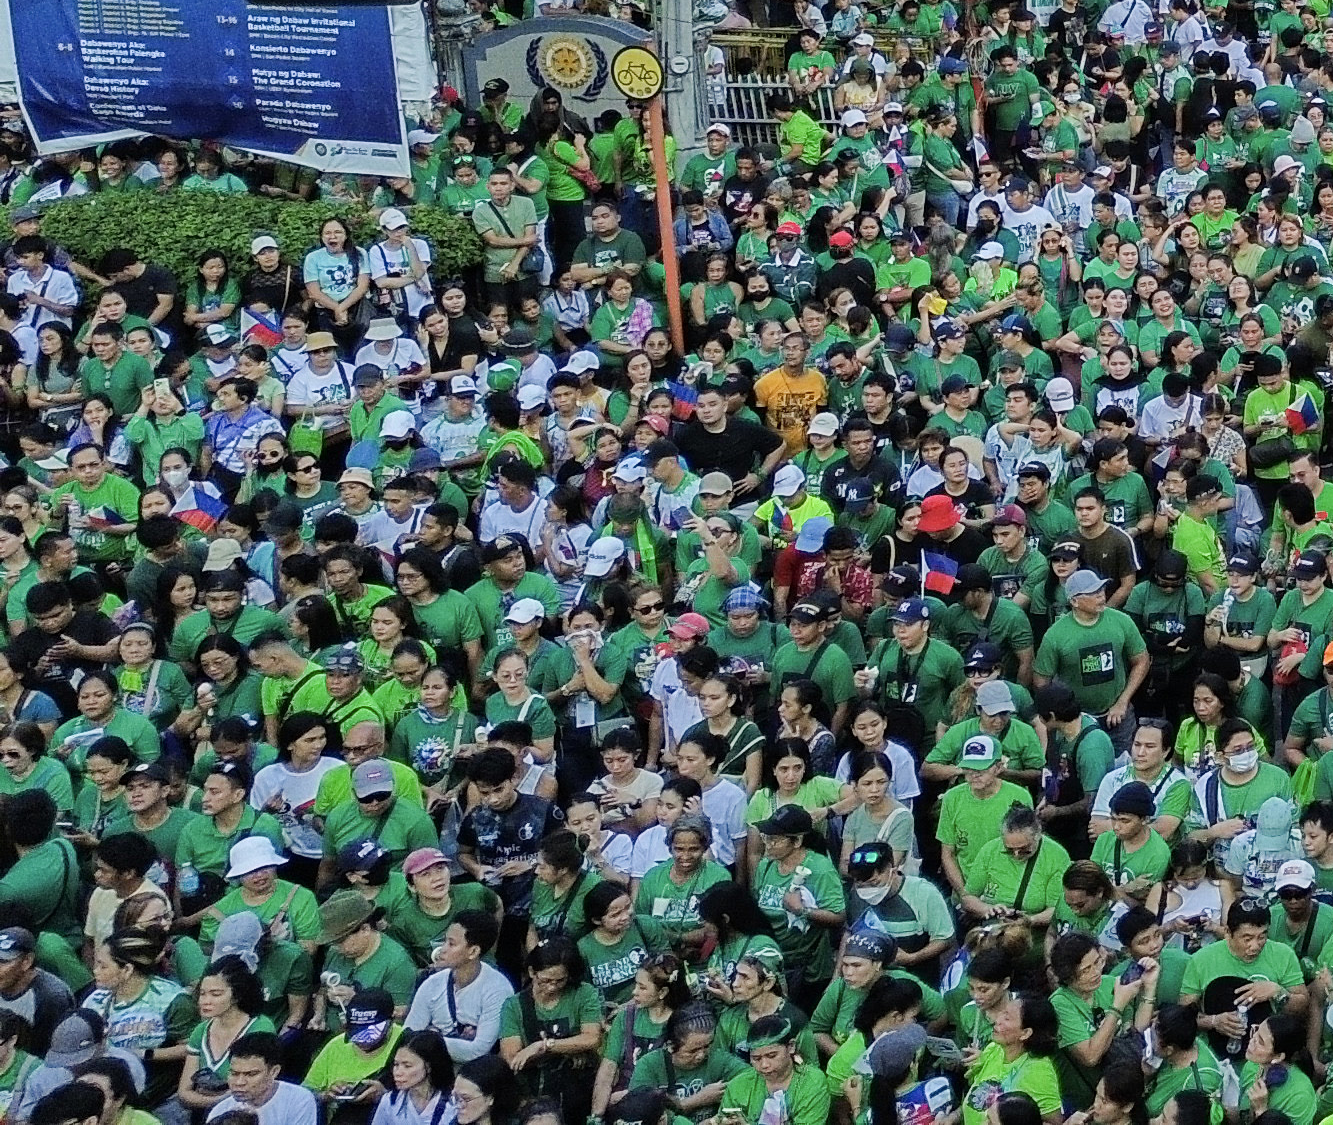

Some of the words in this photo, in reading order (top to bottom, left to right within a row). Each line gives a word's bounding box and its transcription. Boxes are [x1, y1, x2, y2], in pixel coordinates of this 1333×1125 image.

[247, 14, 268, 23] Araw
[269, 16, 281, 24] ng
[282, 16, 310, 25] Dabaw
[248, 23, 289, 32] Basketball
[83, 55, 115, 65] Walking
[116, 56, 135, 64] Tour
[252, 76, 268, 85] The
[269, 77, 295, 86] Grand
